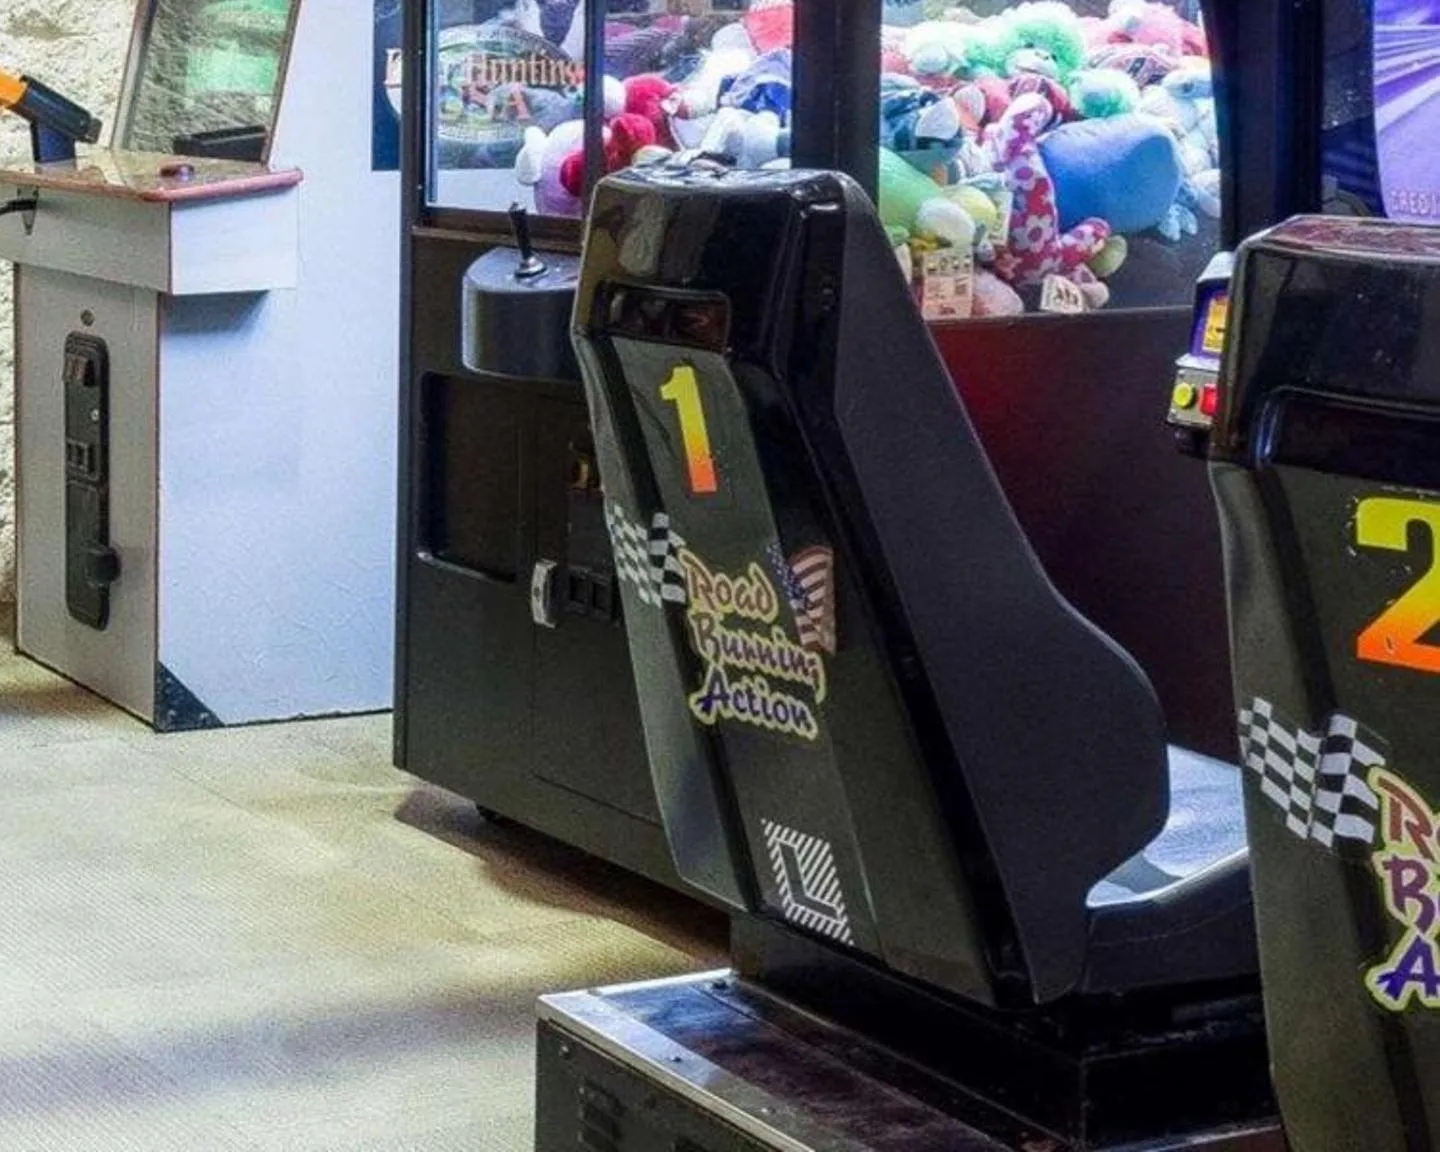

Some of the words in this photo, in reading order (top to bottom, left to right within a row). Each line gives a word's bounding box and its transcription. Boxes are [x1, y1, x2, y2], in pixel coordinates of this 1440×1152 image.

[661, 365, 717, 492] 1
[679, 548, 779, 623] Road
[1357, 496, 1440, 673] 2
[689, 665, 818, 739] Action
